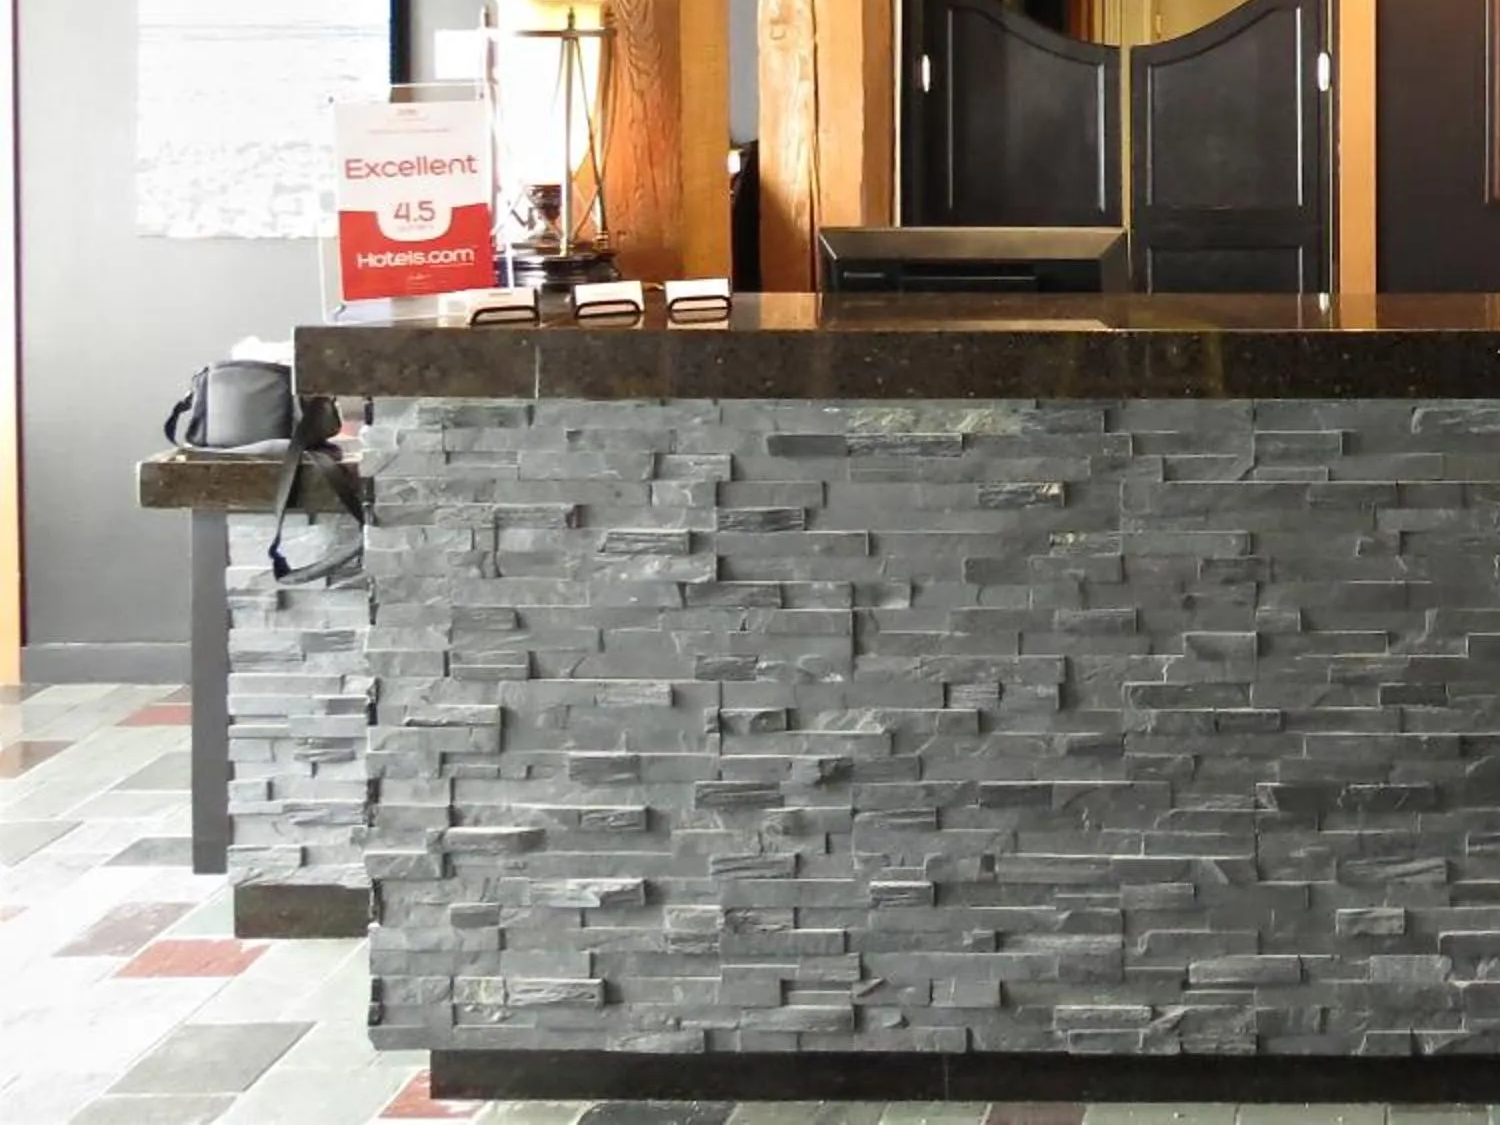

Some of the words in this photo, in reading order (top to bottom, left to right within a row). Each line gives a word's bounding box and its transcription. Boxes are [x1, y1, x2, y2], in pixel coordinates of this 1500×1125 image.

[344, 154, 478, 180] Excellent
[393, 200, 436, 222] 4.5
[356, 247, 475, 269] Hotels.com
